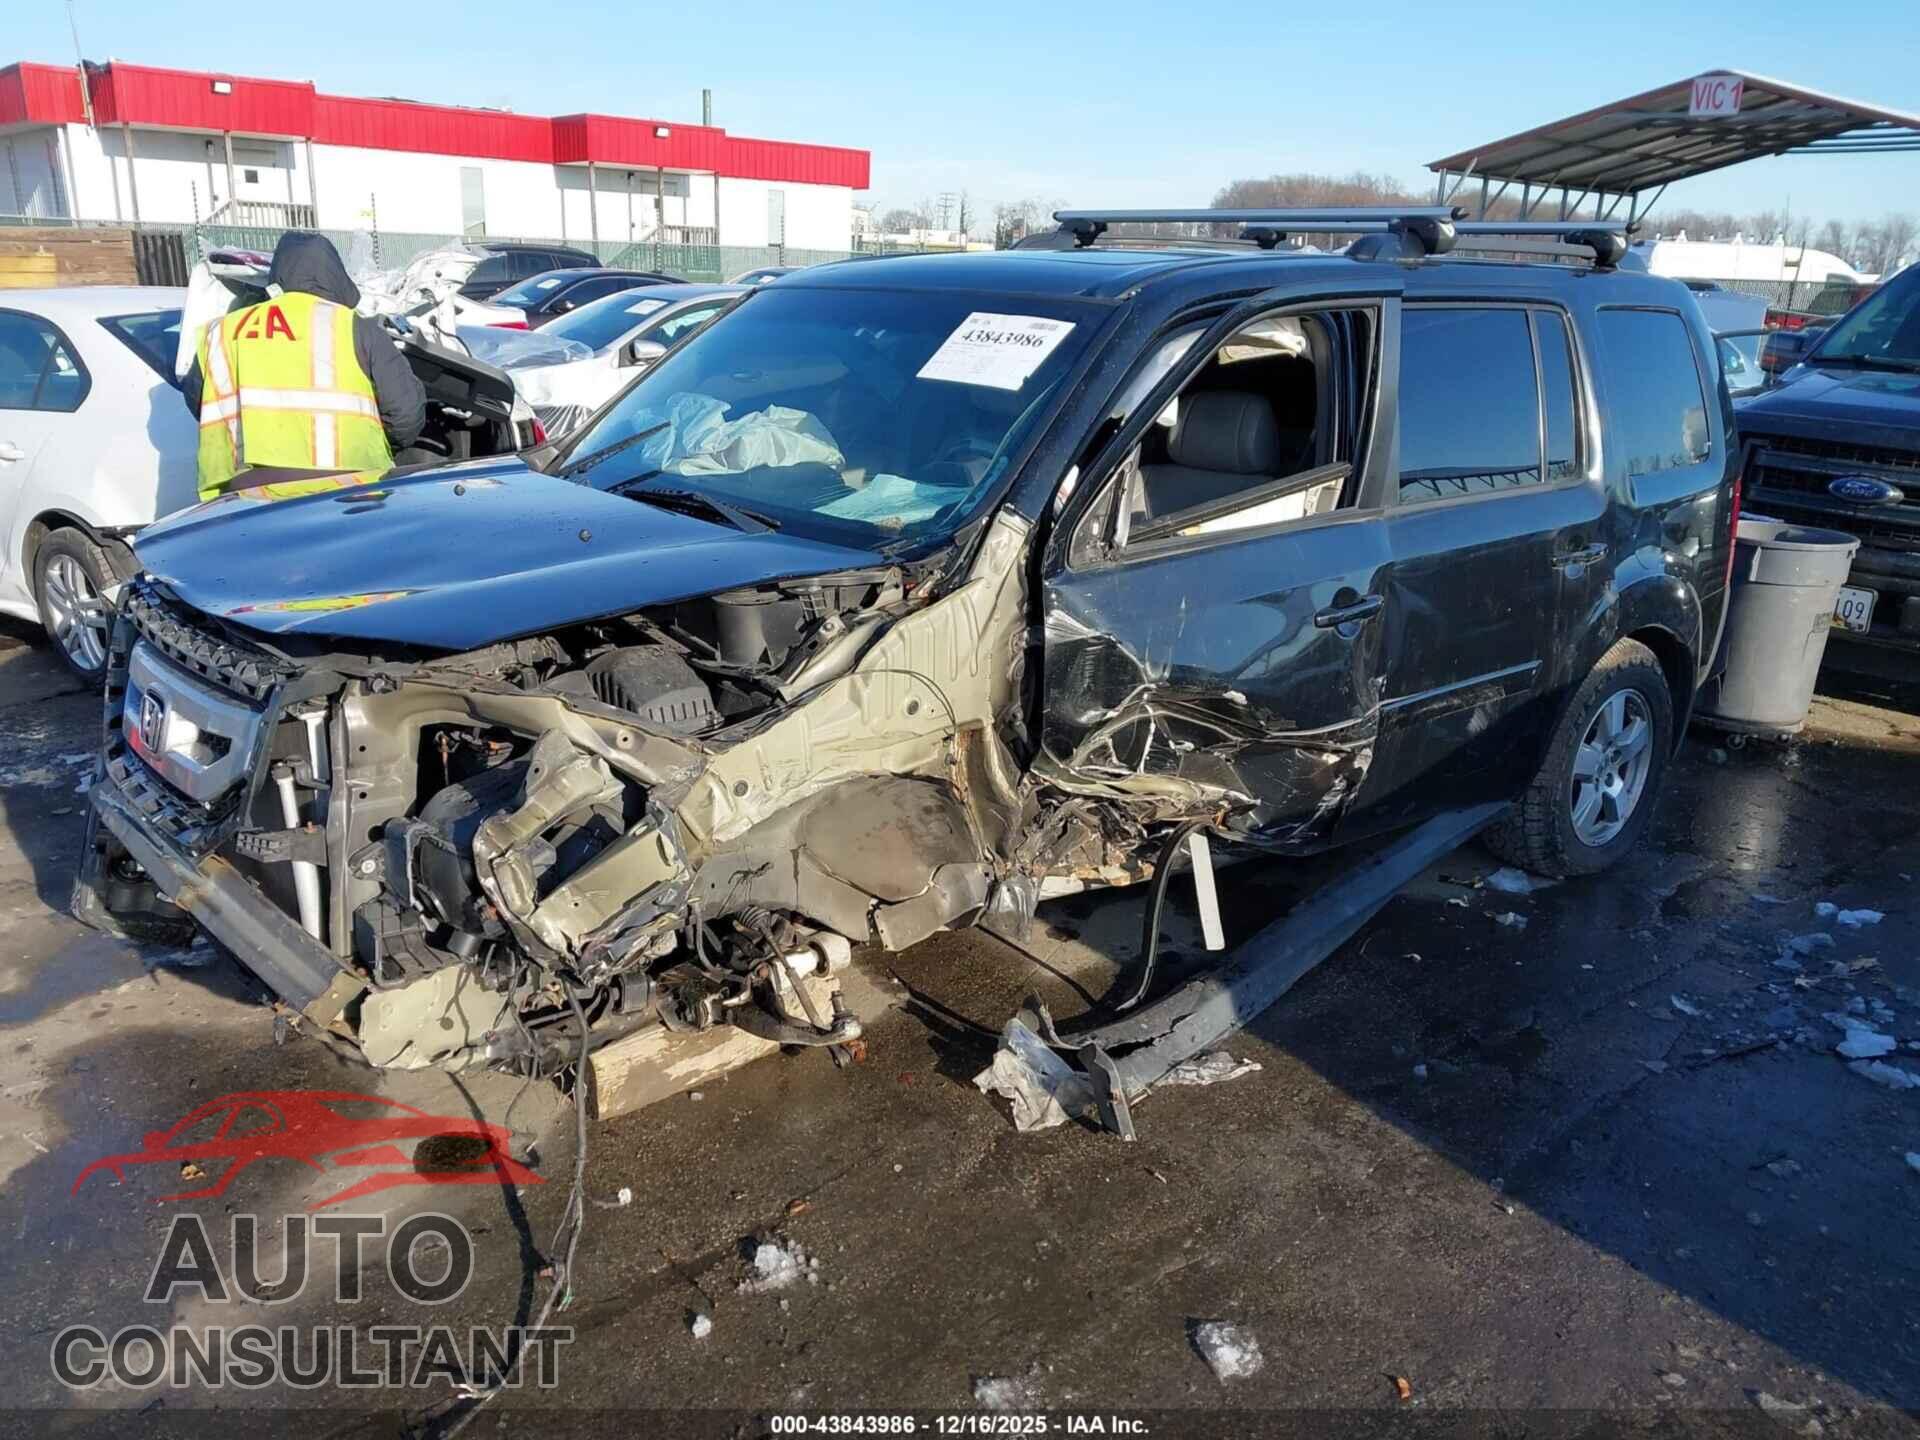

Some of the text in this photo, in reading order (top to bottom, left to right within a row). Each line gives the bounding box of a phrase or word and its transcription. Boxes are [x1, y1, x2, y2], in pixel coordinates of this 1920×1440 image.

[1694, 80, 1744, 111] VIC 1
[962, 329, 1045, 348] 43843986
